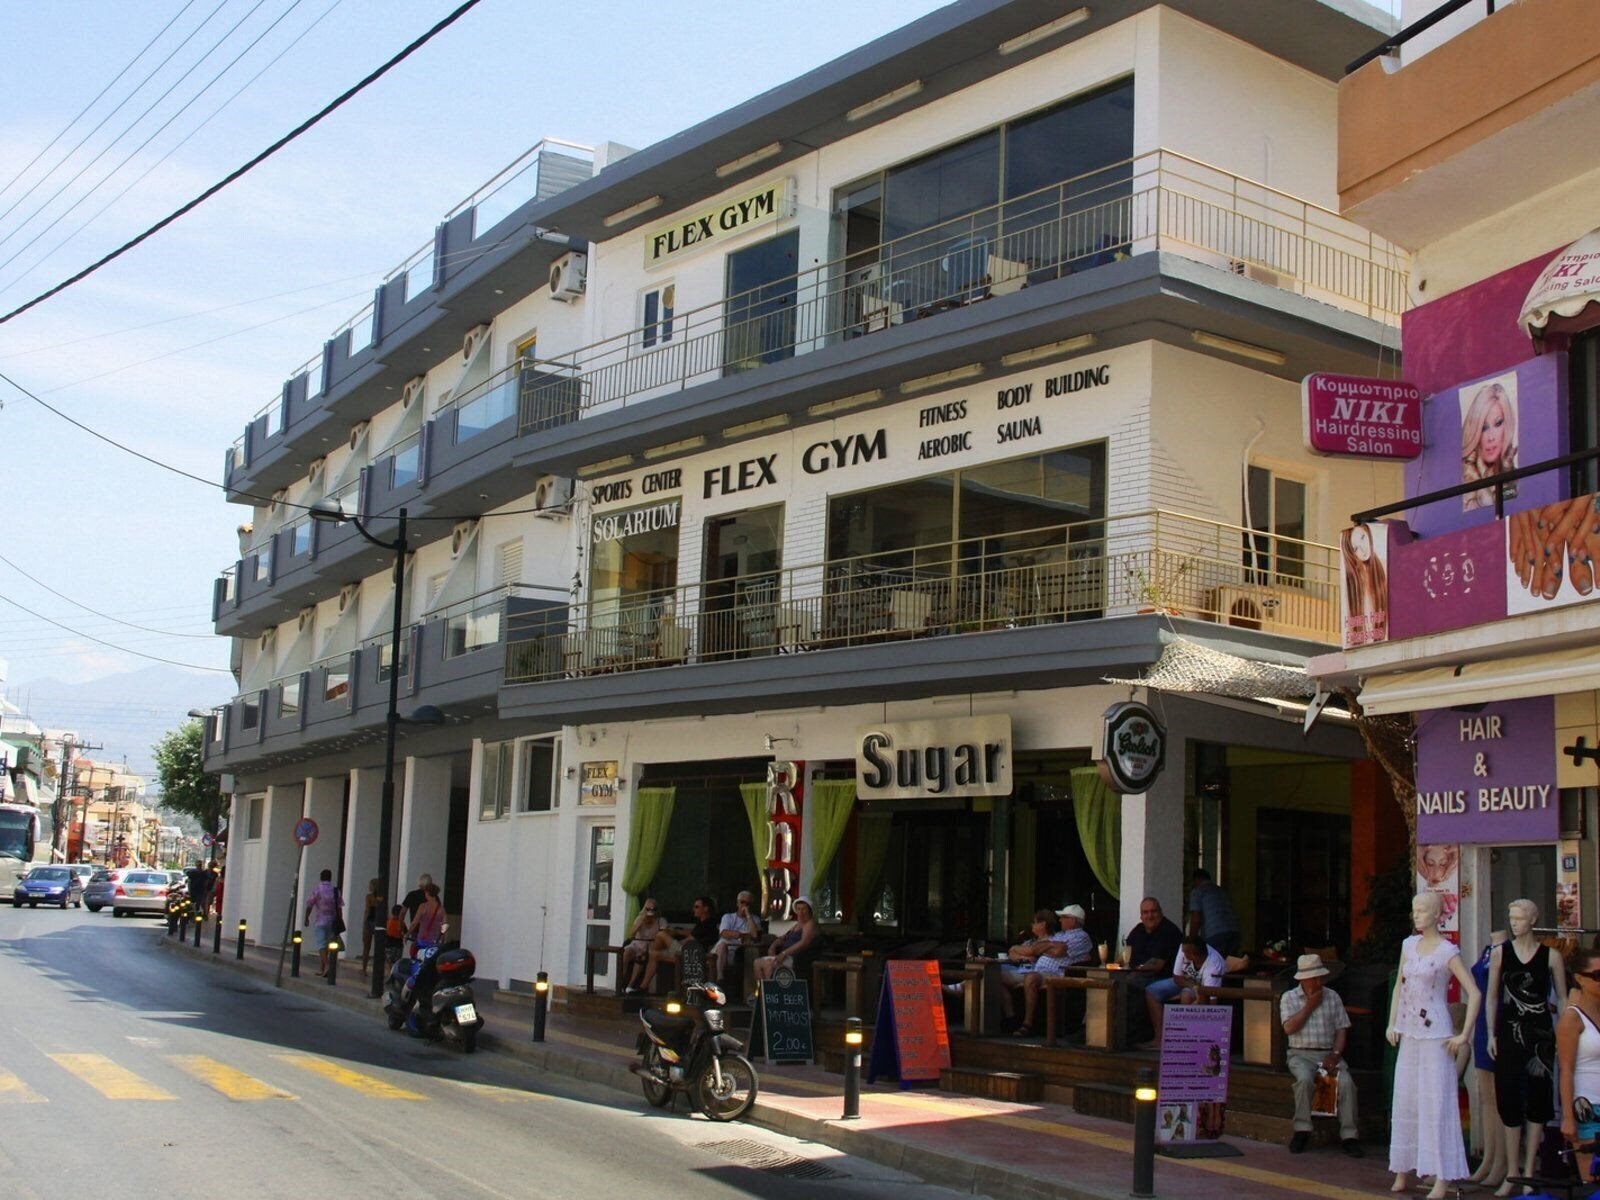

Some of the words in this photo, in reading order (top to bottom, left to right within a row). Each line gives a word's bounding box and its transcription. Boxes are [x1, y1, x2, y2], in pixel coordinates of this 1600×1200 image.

[653, 214, 714, 259] FLEX
[719, 189, 775, 231] GYM
[919, 399, 967, 428] FITNESS
[997, 383, 1033, 410] BODY
[1045, 364, 1110, 398] BUILDING
[1316, 378, 1418, 400] Κομμωτηριο
[1330, 397, 1407, 424] NIKI
[918, 431, 972, 460] AEROBIC
[996, 416, 1042, 444] SAUNA
[1316, 418, 1420, 444] Hairdressing
[1347, 437, 1393, 454] Salon
[592, 478, 632, 505] SPORTS
[642, 468, 683, 494] CENTER
[703, 453, 777, 499] FLEX
[802, 428, 887, 475] GYM
[593, 501, 680, 544] SOLARIUM
[1460, 715, 1502, 741] HAIR
[586, 767, 609, 779] FLEX
[862, 732, 1001, 794] Sugar
[1473, 752, 1488, 777] &
[591, 784, 613, 797] GYM
[1417, 789, 1466, 814] NAILS
[1478, 785, 1550, 812] BEAUTY
[783, 994, 804, 1005] BEER
[768, 1008, 809, 1026] MYTHOS
